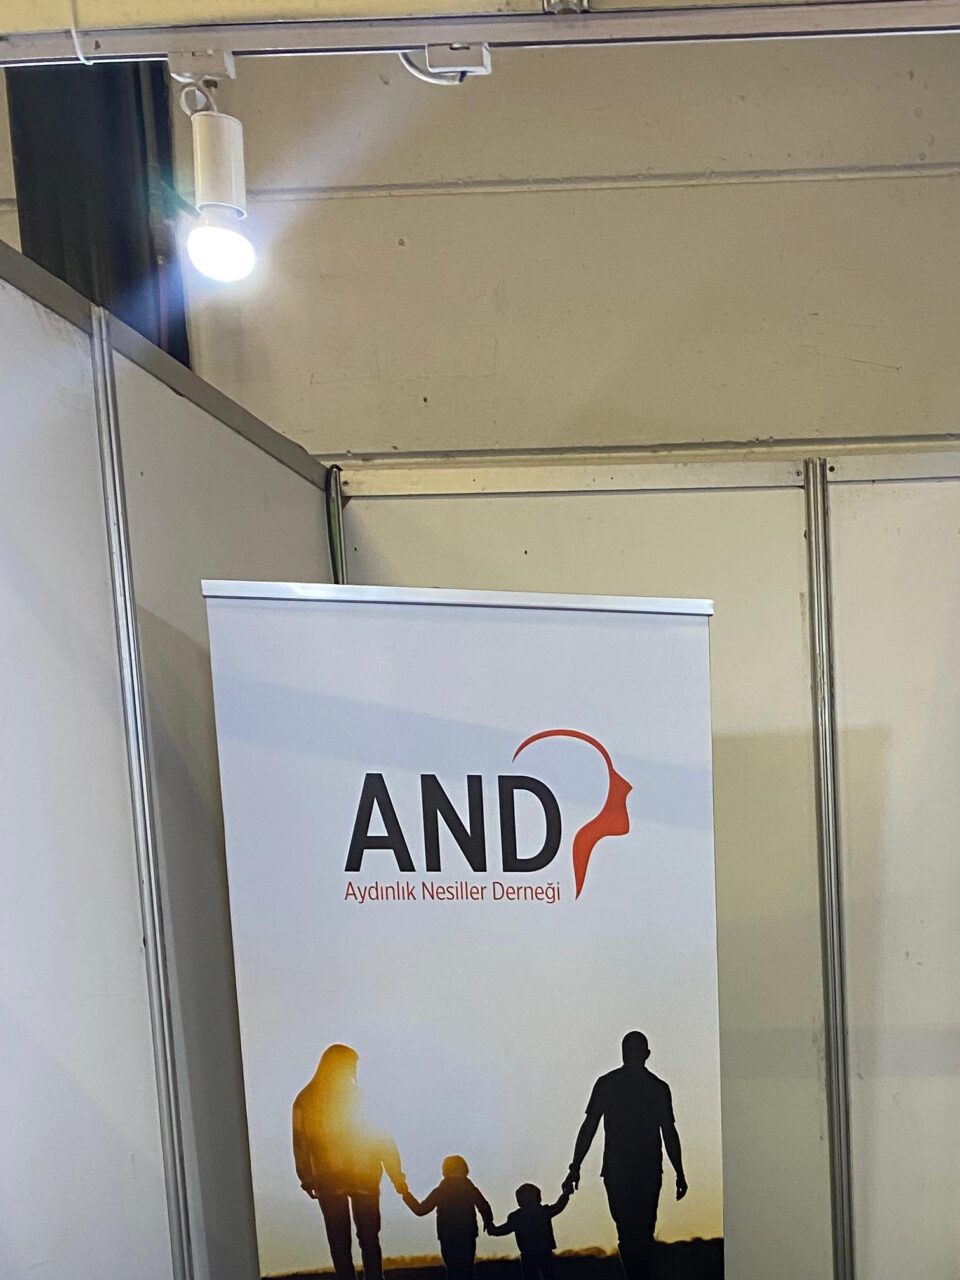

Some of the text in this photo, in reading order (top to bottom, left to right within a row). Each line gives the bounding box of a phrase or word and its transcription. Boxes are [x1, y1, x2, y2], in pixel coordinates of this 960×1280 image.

[344, 772, 563, 873] AND
[344, 880, 561, 905] Aydınlık Nesiller Derneği
